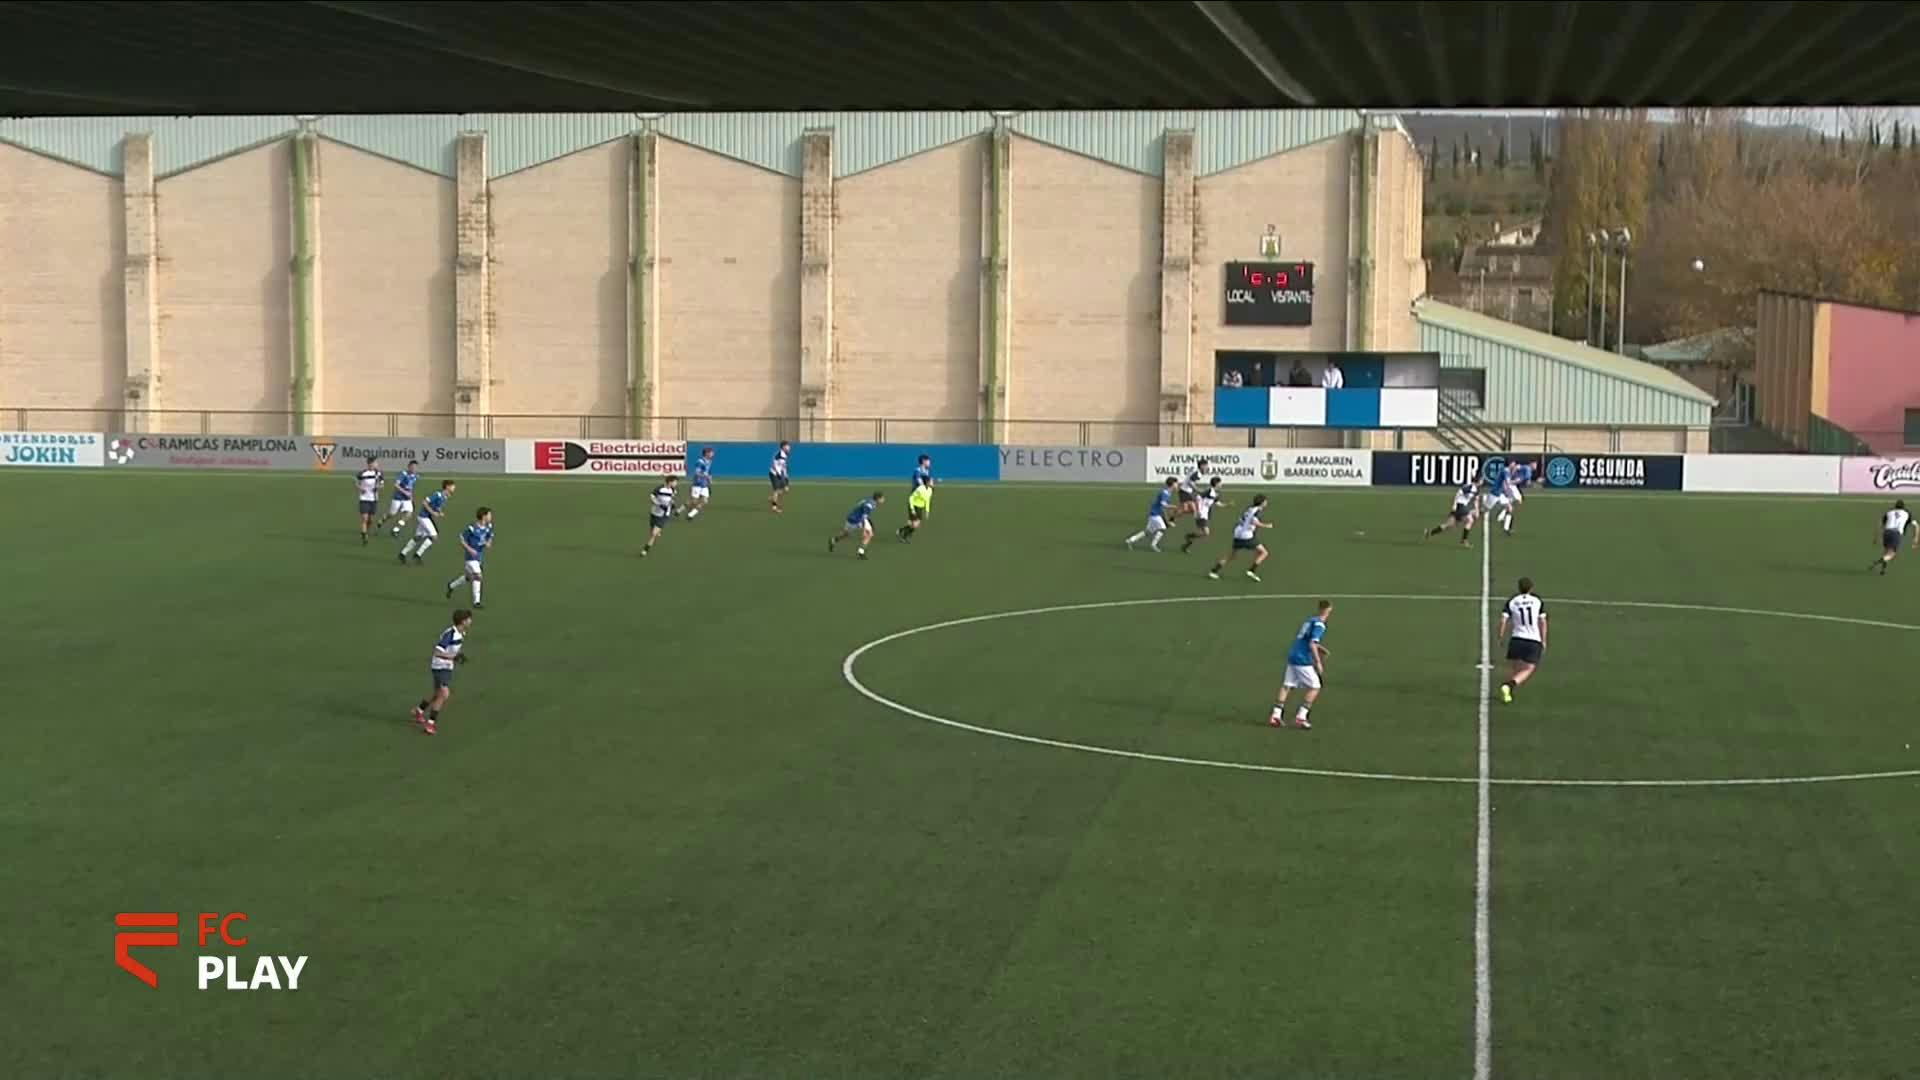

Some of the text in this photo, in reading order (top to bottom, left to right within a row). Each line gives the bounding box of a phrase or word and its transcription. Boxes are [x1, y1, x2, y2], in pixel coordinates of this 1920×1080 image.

[1227, 289, 1255, 304] LOCAL
[223, 438, 297, 452] PAMPLONA
[590, 442, 686, 454] Electricidad
[342, 446, 500, 461] Maquinaria y Servicios
[1296, 456, 1353, 466] ARANGUREN
[1579, 458, 1645, 477] SEGUNDA
[1154, 466, 1180, 475] VALLE
[1199, 466, 1254, 476] RANGUREN
[1331, 468, 1363, 478] UDALA
[1518, 606, 1533, 626] 11
